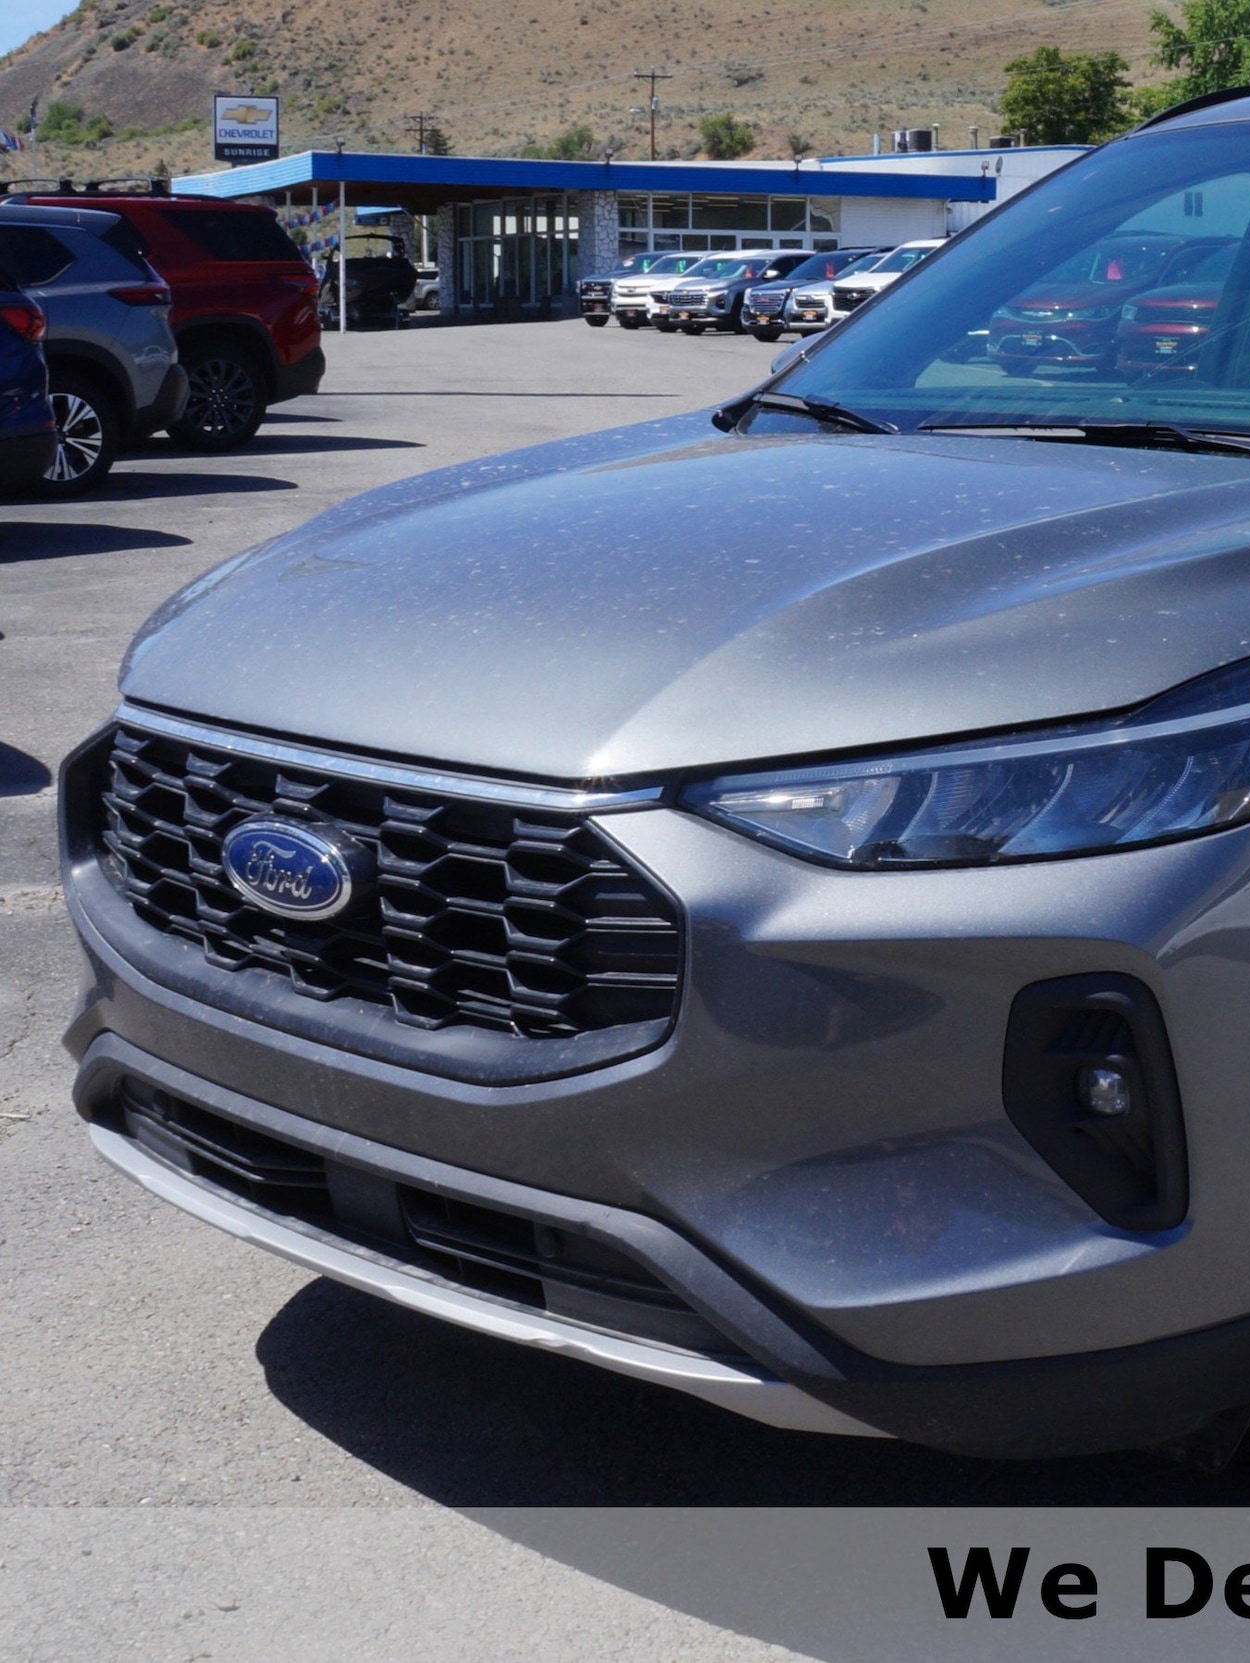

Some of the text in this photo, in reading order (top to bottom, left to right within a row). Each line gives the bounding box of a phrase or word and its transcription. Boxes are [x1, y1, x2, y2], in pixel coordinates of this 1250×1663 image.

[219, 129, 274, 138] CHEVROLET
[224, 148, 270, 156] SUNRISE
[246, 840, 314, 899] Ford
